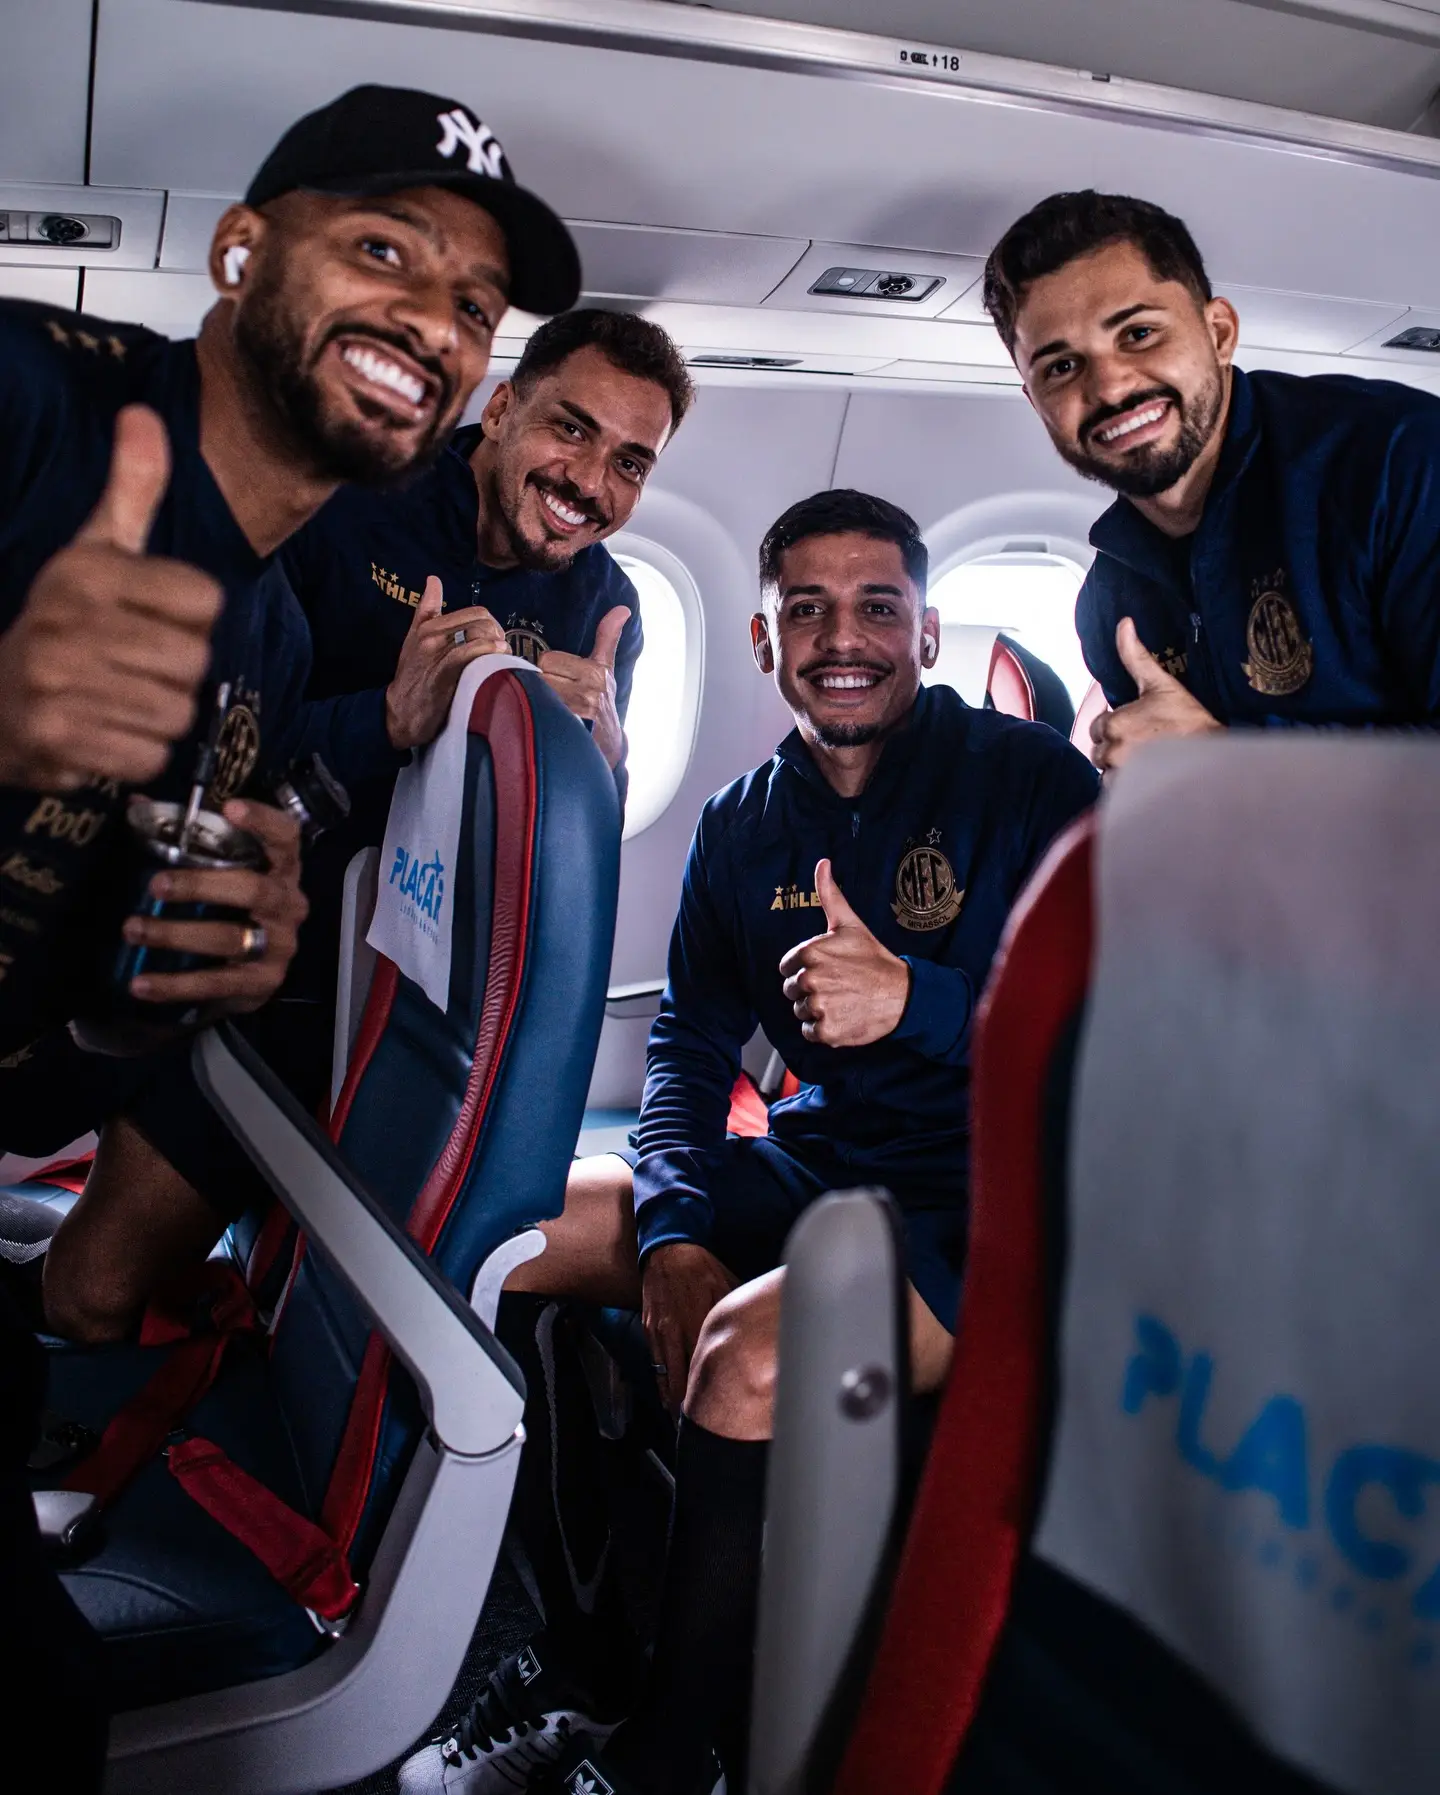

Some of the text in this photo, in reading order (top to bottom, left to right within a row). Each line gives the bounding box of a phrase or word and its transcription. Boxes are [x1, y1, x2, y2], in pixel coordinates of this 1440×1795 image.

[941, 54, 960, 72] 18
[436, 108, 503, 180] NY
[371, 569, 421, 608] ATHLE
[769, 891, 824, 911] ATHLE
[907, 914, 951, 930] MIRASSOL
[1122, 1314, 1440, 1620] PLAC
